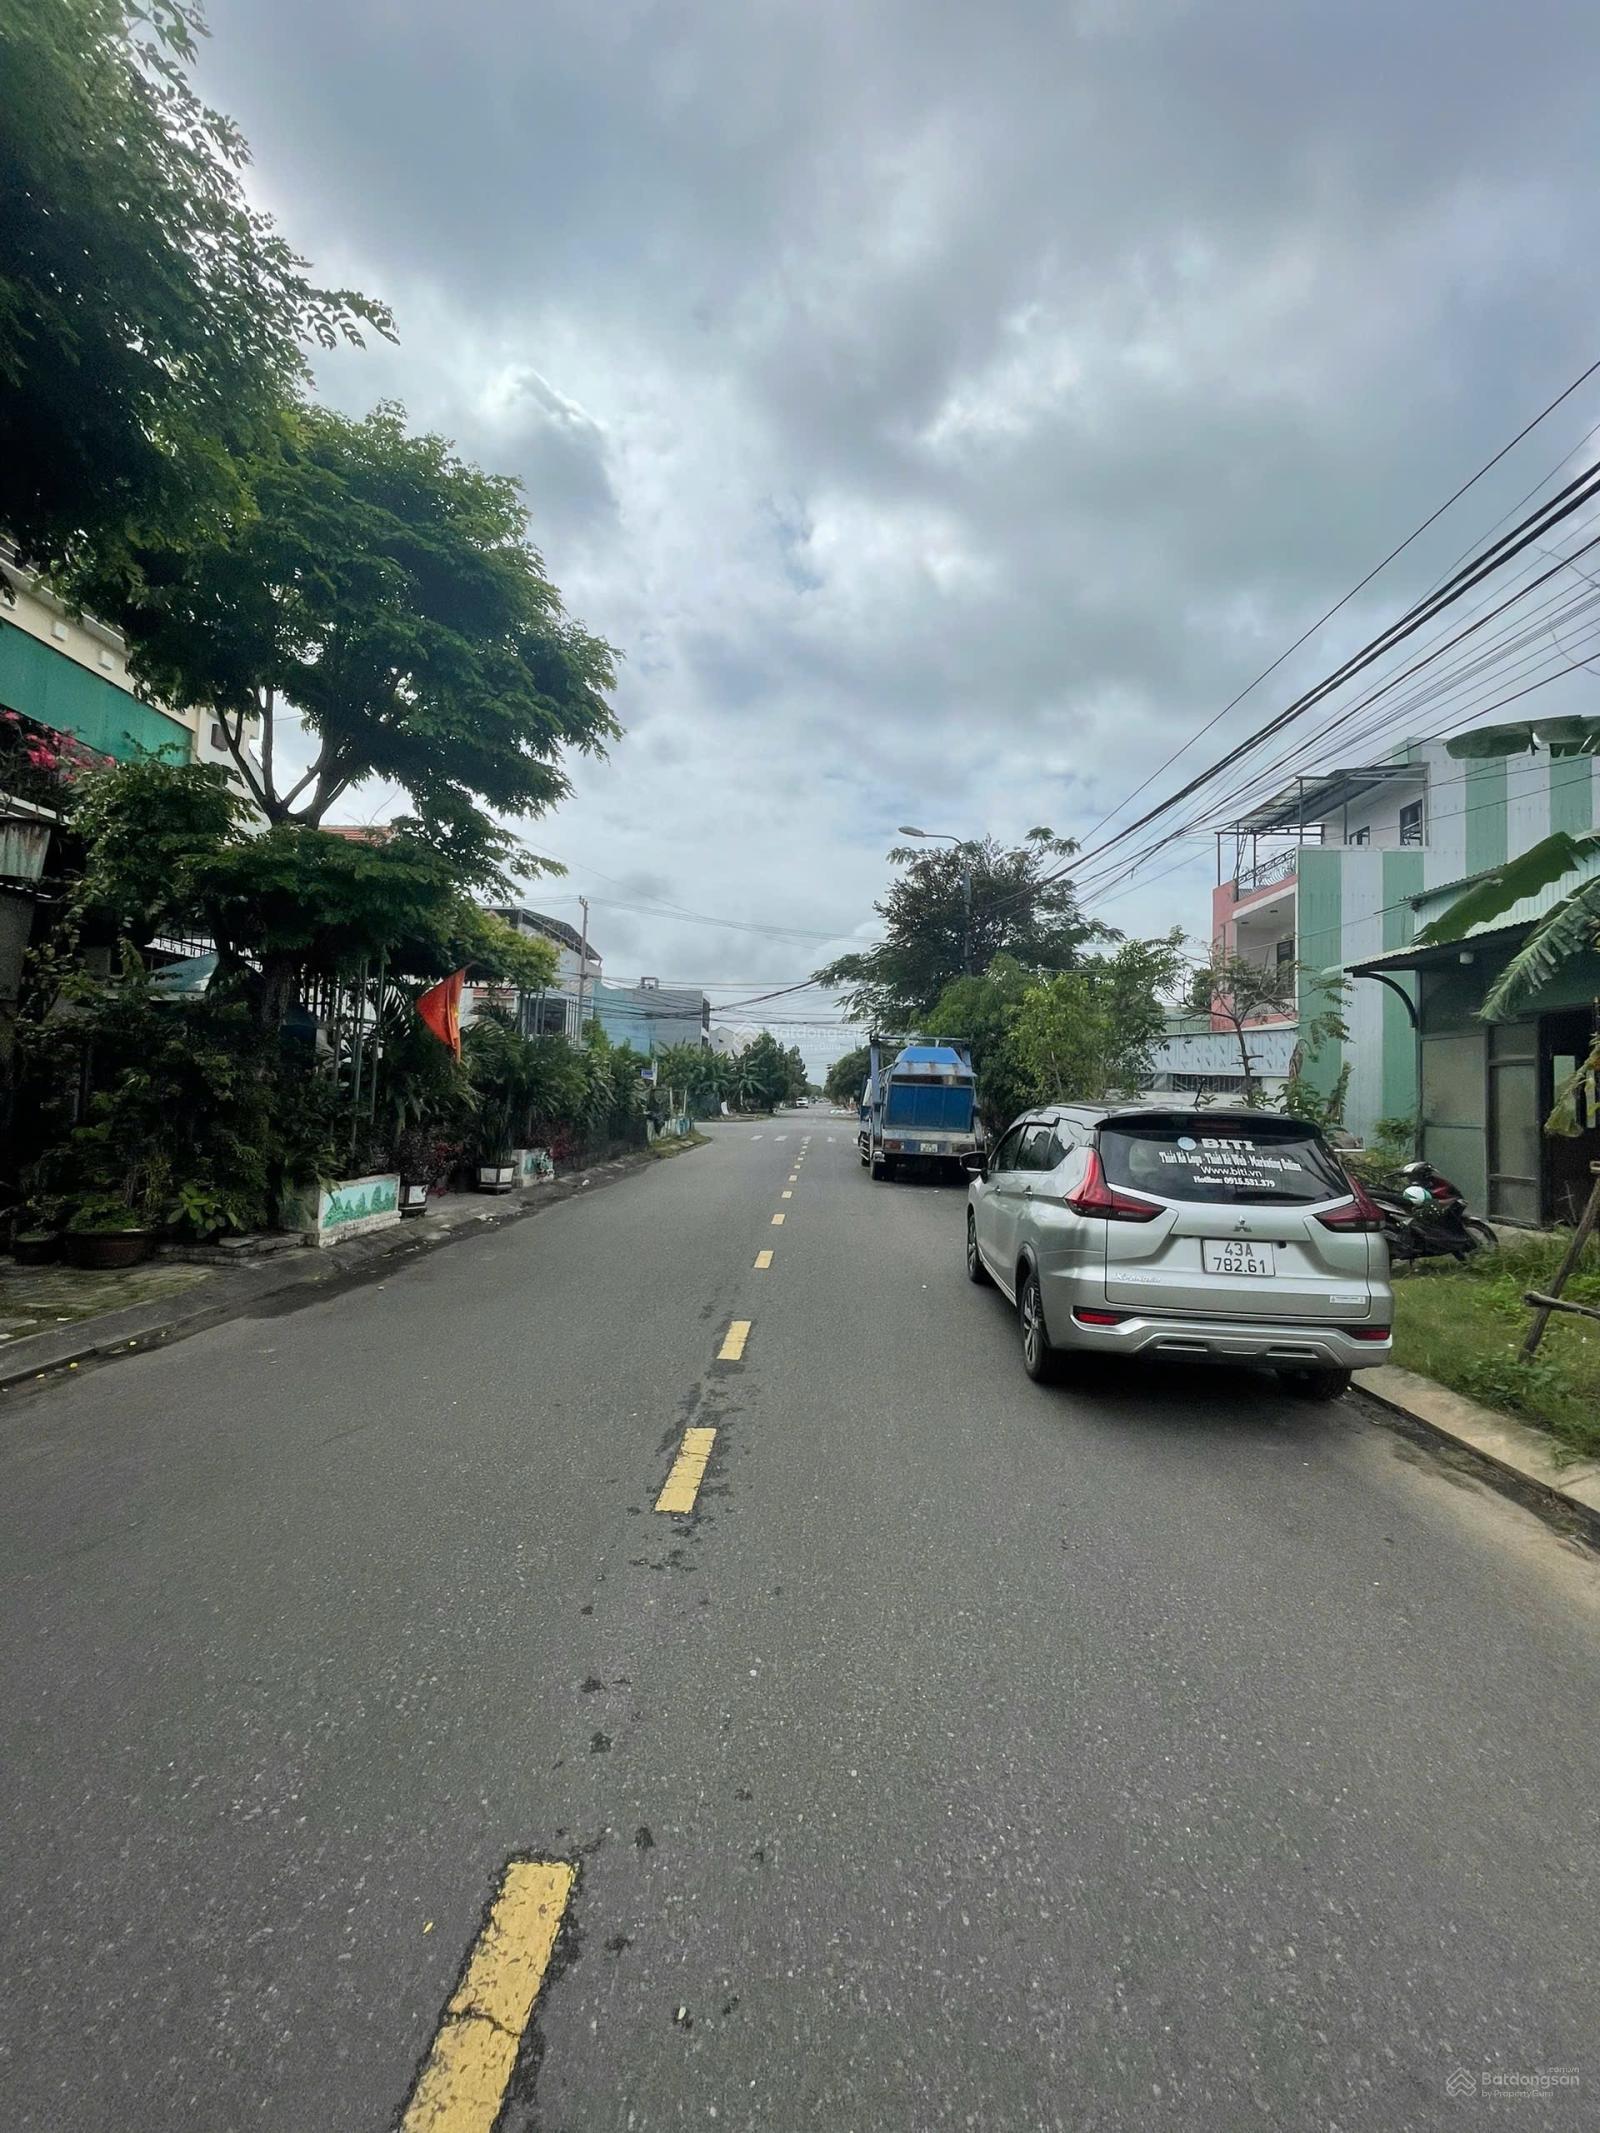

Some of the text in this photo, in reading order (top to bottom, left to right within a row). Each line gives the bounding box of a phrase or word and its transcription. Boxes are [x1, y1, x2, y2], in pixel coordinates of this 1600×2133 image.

[1201, 1138, 1255, 1151] BITI
[1224, 1242, 1254, 1257] 43A
[1213, 1256, 1266, 1274] 782.61
